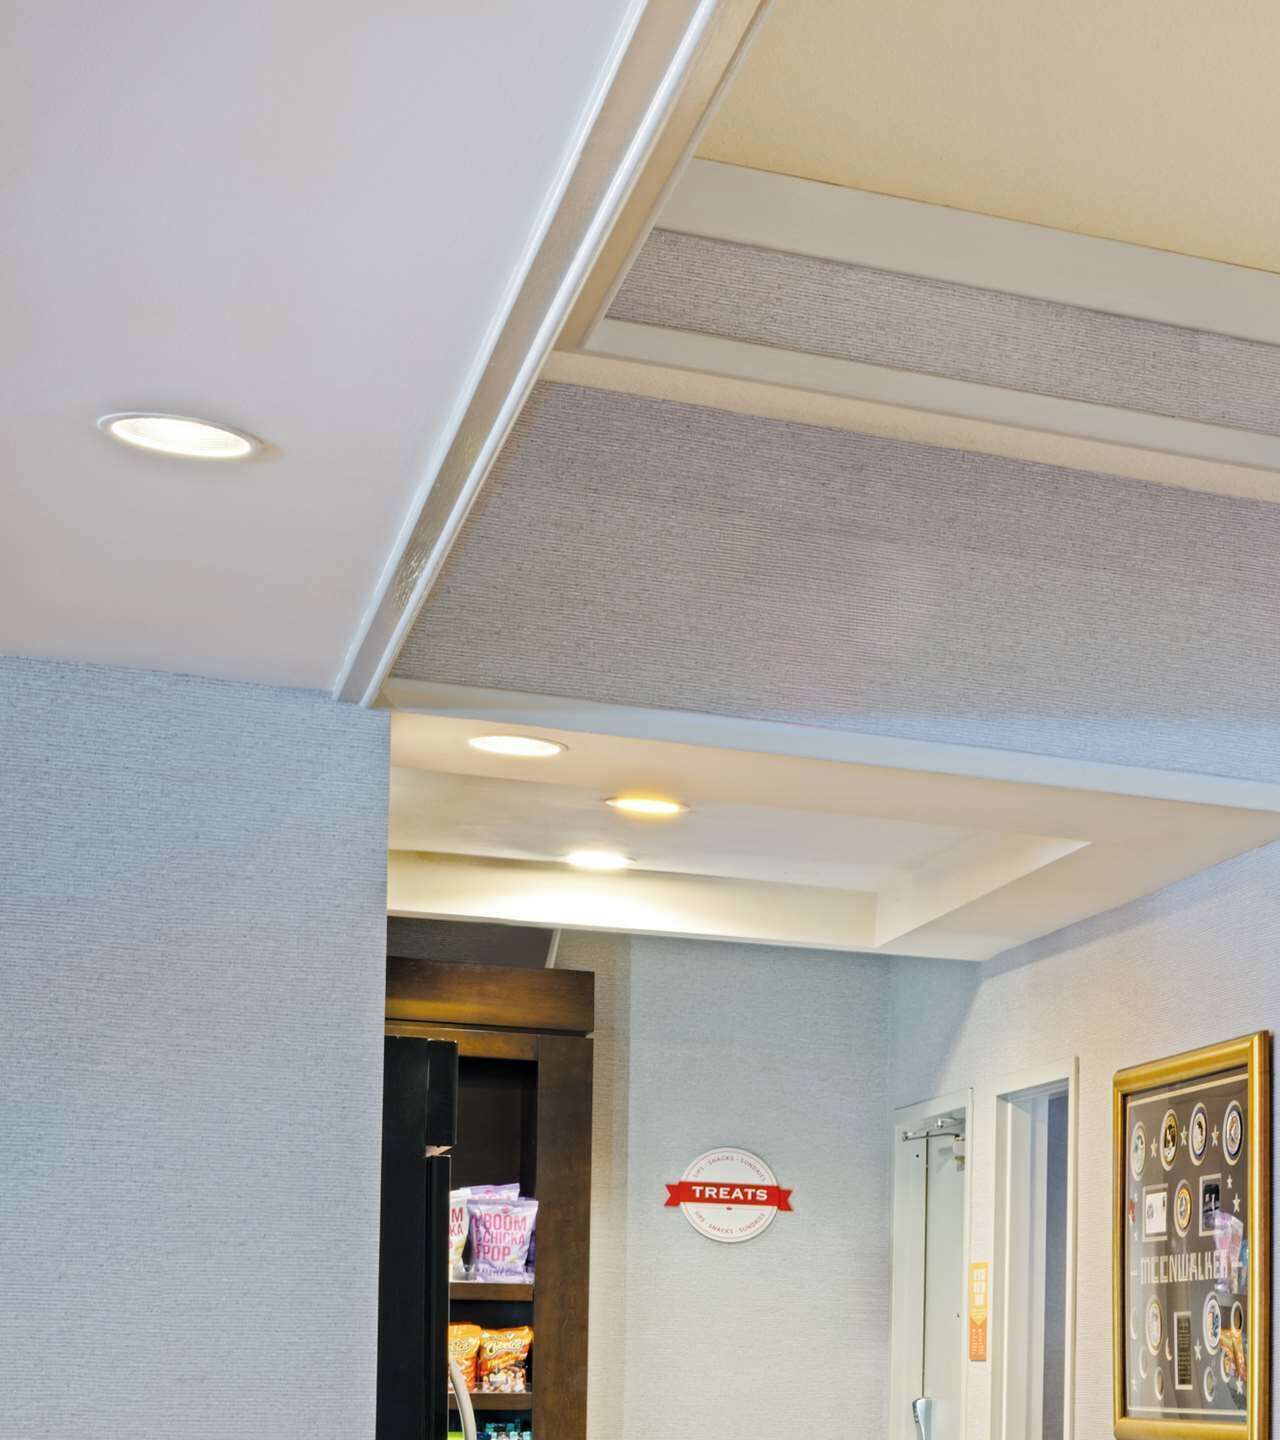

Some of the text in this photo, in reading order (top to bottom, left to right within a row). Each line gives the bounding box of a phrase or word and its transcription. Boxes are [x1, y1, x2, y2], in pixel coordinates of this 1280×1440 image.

[692, 1185, 768, 1201] TREATS
[483, 1213, 527, 1232] BOOM
[483, 1229, 526, 1247] CHICKA
[483, 1244, 511, 1261] POP
